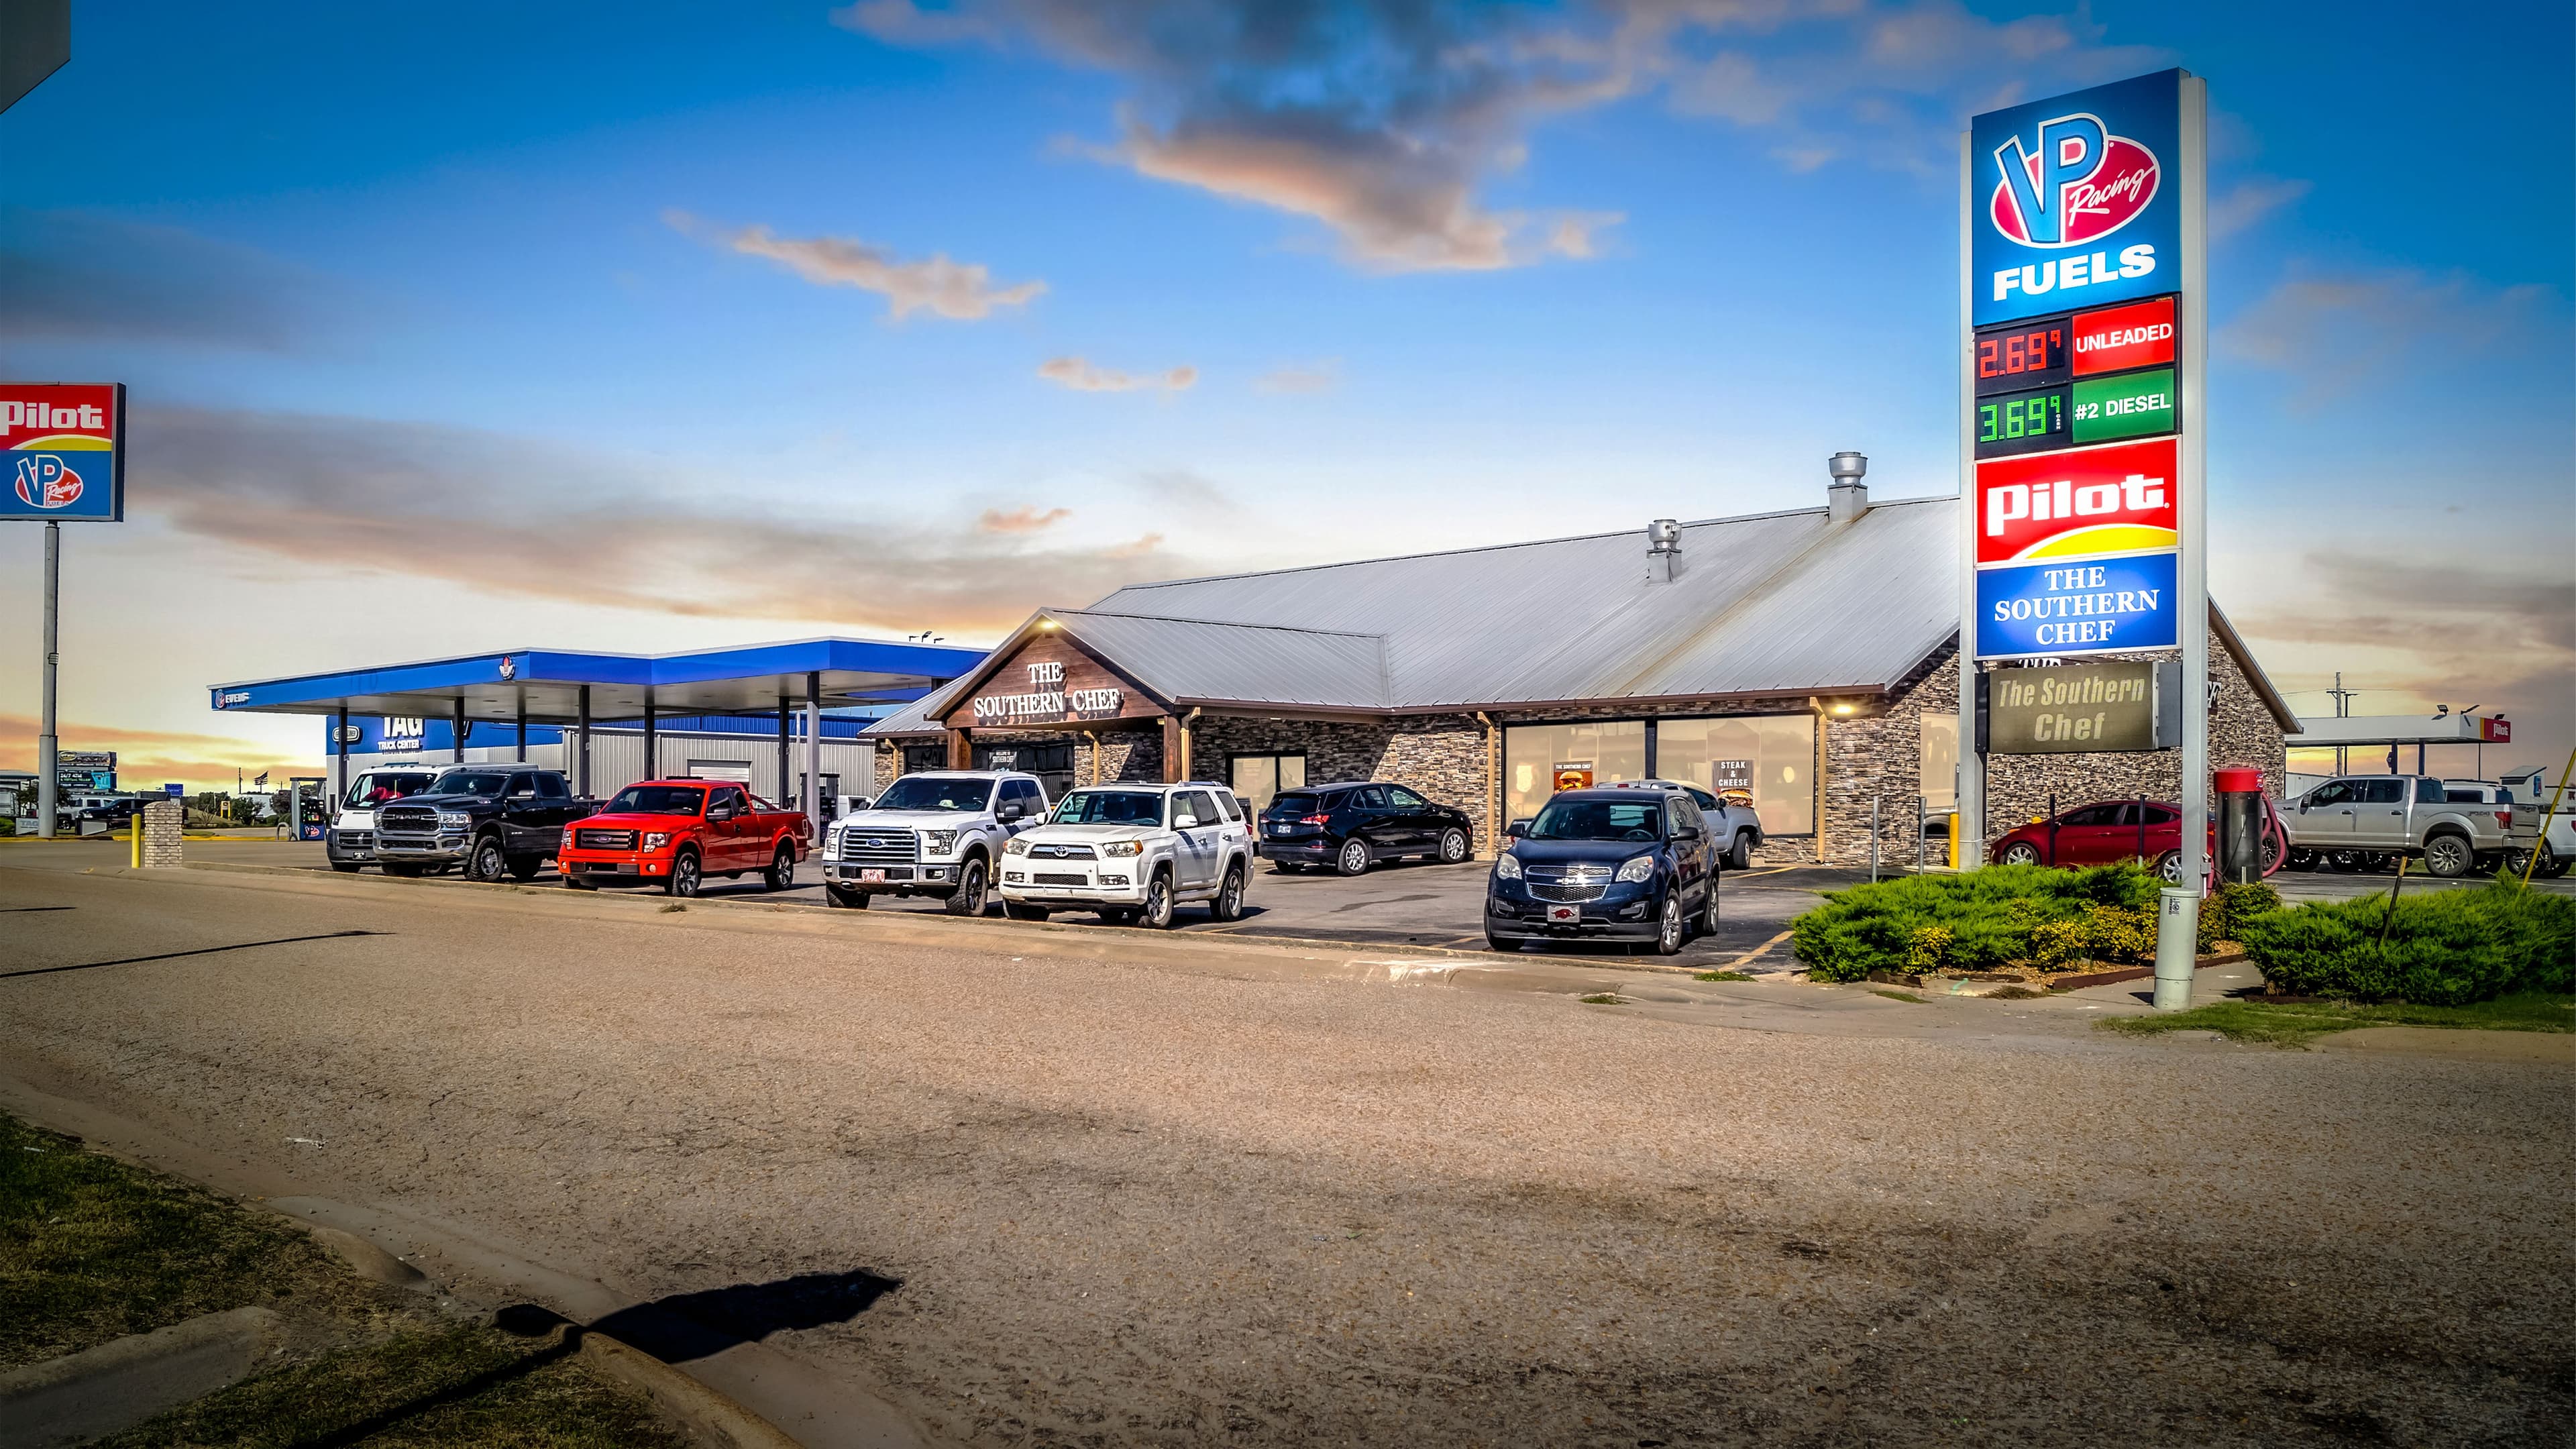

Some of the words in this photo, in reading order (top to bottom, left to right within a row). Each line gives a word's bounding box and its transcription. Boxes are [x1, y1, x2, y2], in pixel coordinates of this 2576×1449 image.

[1993, 113, 2108, 244] VP
[2068, 169, 2147, 227] Racing
[1993, 244, 2156, 301] FUELS
[2076, 323, 2173, 353] UNLEADED
[0, 400, 103, 436] Pilot
[2074, 402, 2099, 421] #2
[2105, 393, 2171, 417] DIESEL
[17, 454, 64, 506] VP
[1987, 474, 2165, 537] Pilot
[2045, 566, 2106, 591] THE
[1994, 589, 2160, 622] SOUTHERN
[2036, 620, 2116, 645] CHEF
[1027, 661, 1063, 684] THE
[973, 691, 1064, 718] SOUTHERN
[1072, 688, 1120, 712] CHEF
[1999, 680, 2035, 708] The
[2041, 676, 2145, 707] Southern
[384, 716, 424, 738] TAG
[2034, 712, 2106, 742] Chef
[377, 741, 397, 751] TRUCK
[397, 739, 420, 749] CENTER
